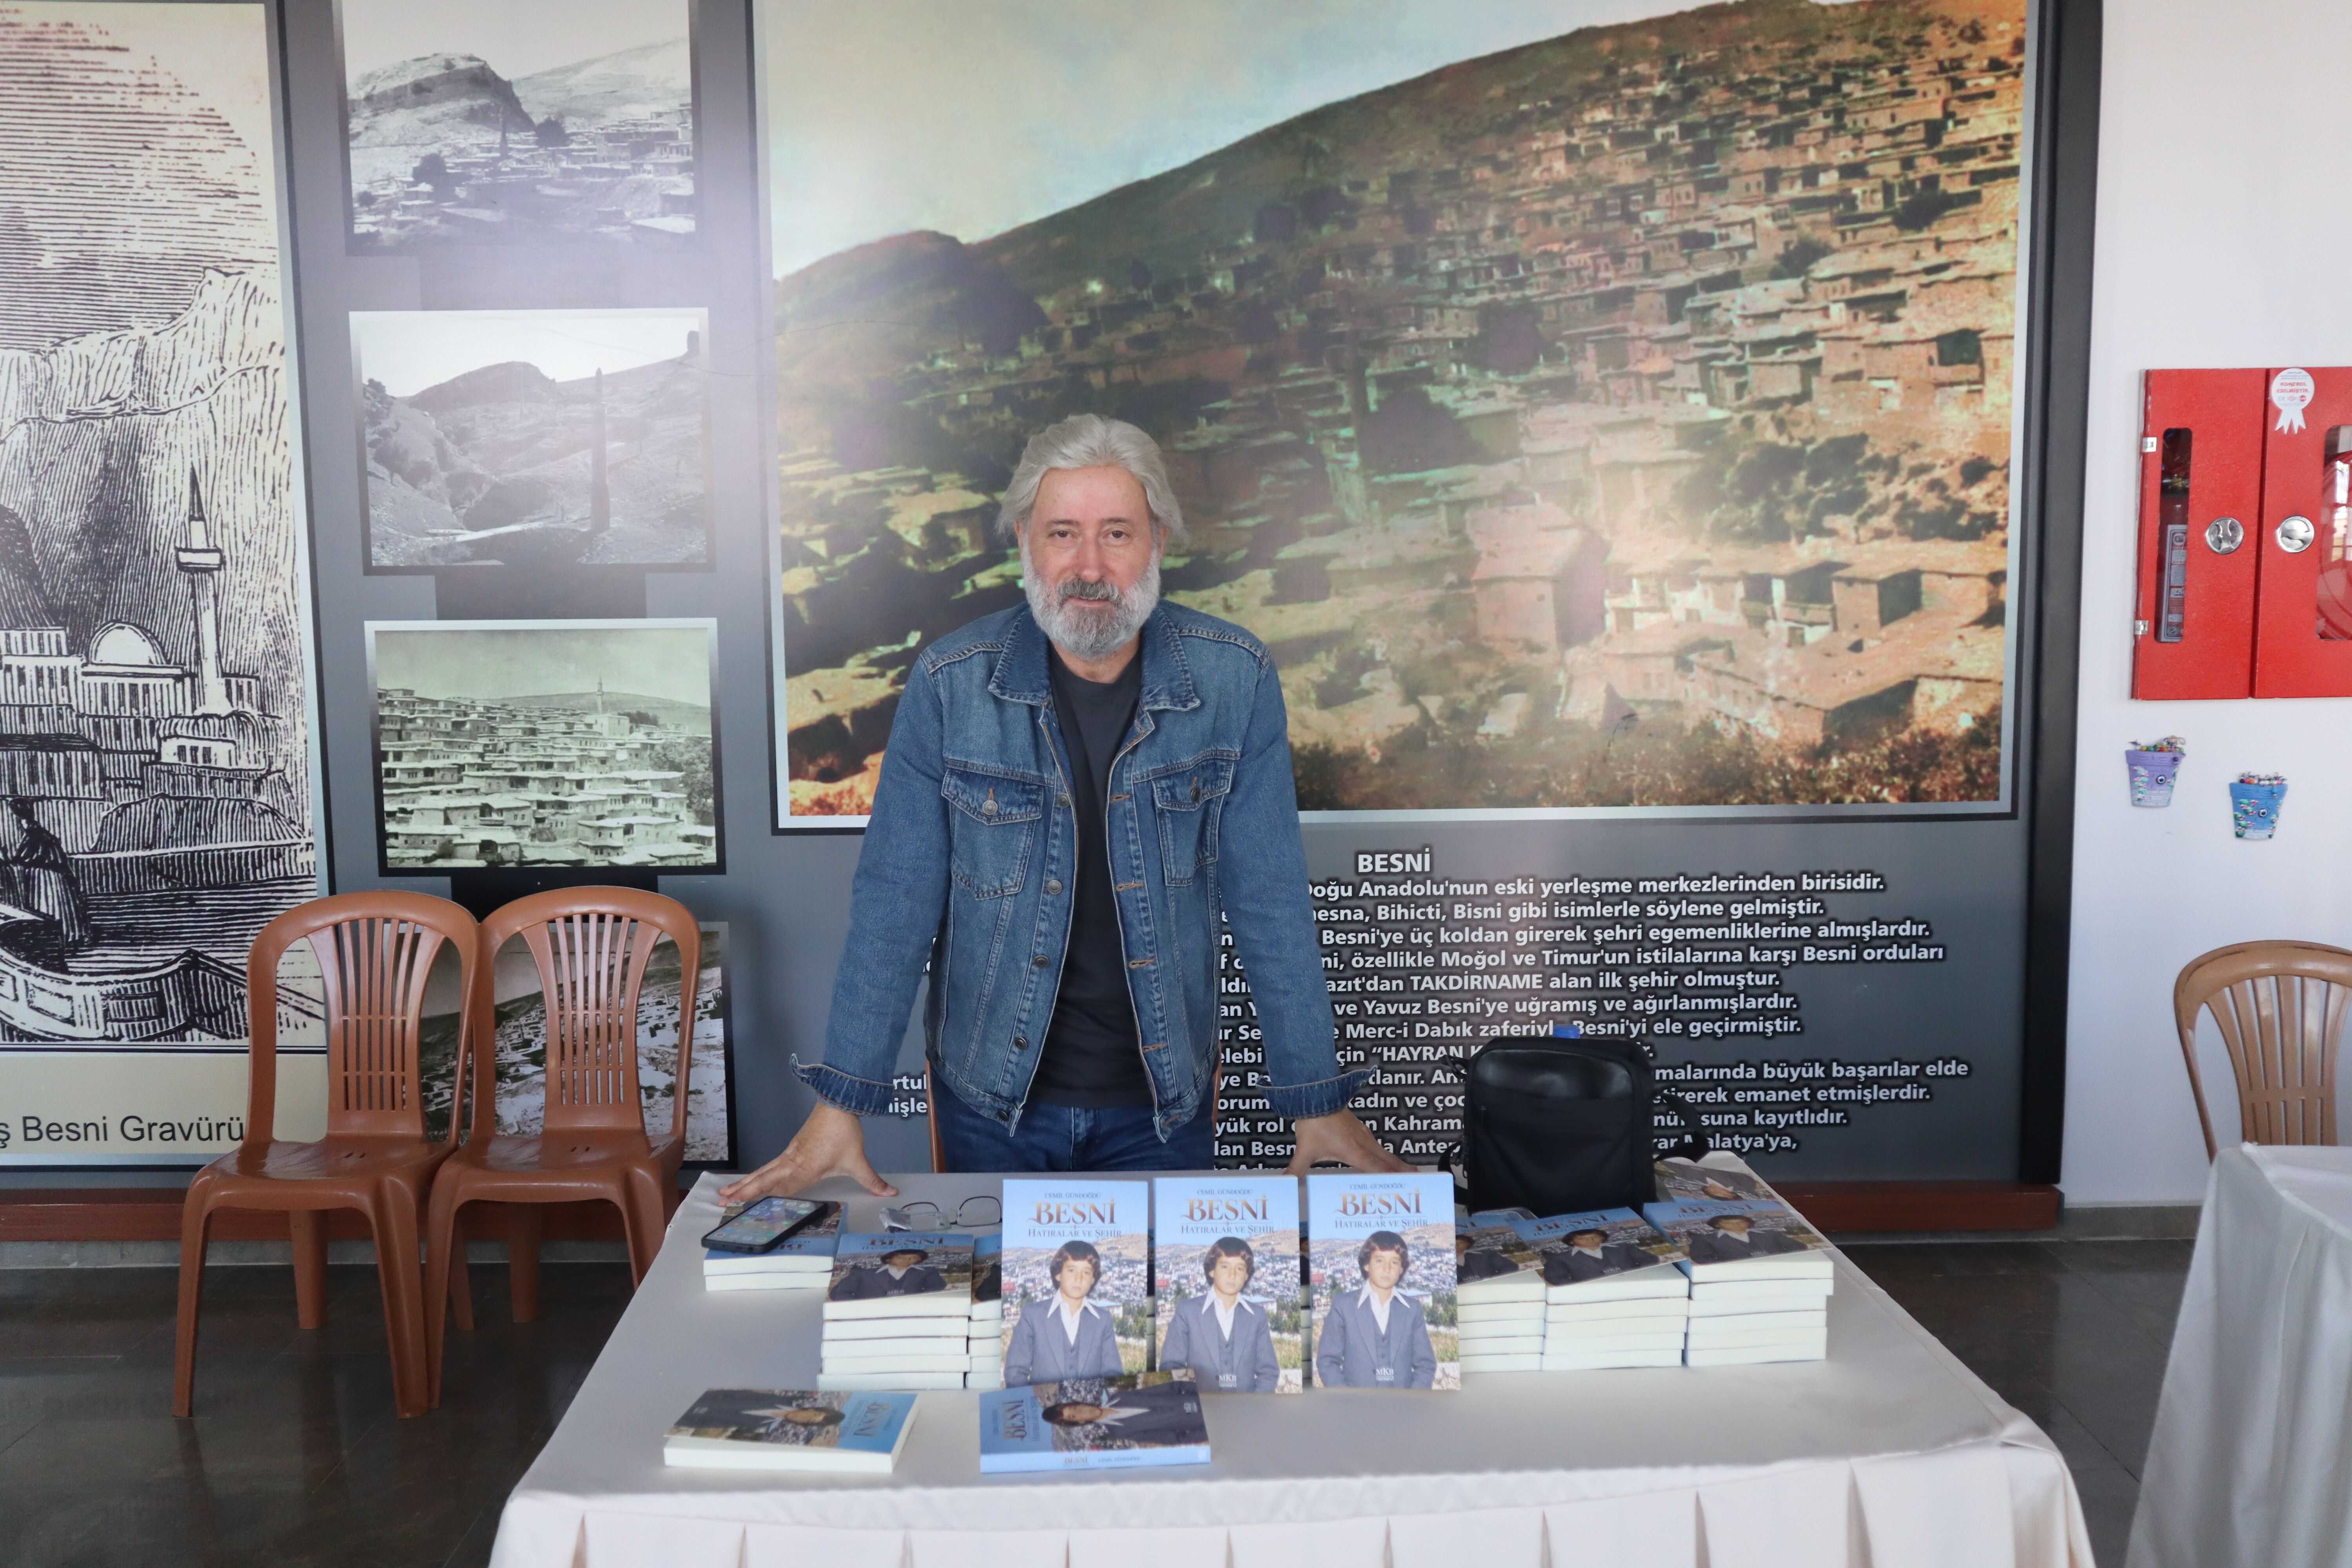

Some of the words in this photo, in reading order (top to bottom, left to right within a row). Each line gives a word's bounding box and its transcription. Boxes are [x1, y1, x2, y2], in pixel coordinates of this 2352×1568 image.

[1358, 848, 1430, 873] BESNİ
[1309, 881, 1352, 901] oğu
[1359, 880, 1488, 897] Anadolu'nun
[1494, 878, 1534, 895] eski
[1540, 877, 1632, 898] yerleşme
[1639, 875, 1795, 892] merkezlerinden
[1802, 873, 1884, 890] birisidir.
[1377, 903, 1446, 921] Bihicti,
[1454, 902, 1501, 919] Bisni
[1508, 902, 1547, 922] gibi
[1554, 900, 1640, 917] isimlerle
[1646, 900, 1724, 920] söylene
[1730, 898, 1824, 919] gelmiştir.
[1323, 928, 1403, 948] Besni'ye
[1410, 927, 1433, 947] üç
[1440, 926, 1508, 943] koldan
[1515, 925, 1587, 946] girerek
[1594, 924, 1642, 945] şehri
[1649, 922, 1811, 944] egemenliklerine
[1818, 920, 1929, 941] almışlardır.
[1352, 951, 1435, 968] özellikle
[1442, 950, 1506, 970] Moğol
[1512, 954, 1536, 965] ve
[1542, 949, 1630, 965] Timur'un
[1637, 947, 1742, 964] istilalarına
[1750, 946, 1796, 965] karşı
[1804, 945, 1856, 961] Besni
[1863, 944, 1943, 960] orduları
[1410, 971, 1543, 990] TAKDİRNAME
[1550, 973, 1592, 988] alan
[1599, 972, 1622, 987] ilk
[1629, 971, 1678, 991] şehir
[1684, 971, 1779, 990] olmuştur.
[1334, 1004, 1357, 1015] ve
[1363, 1000, 1421, 1014] Yavuz
[1428, 997, 1508, 1017] Besni'ye
[1515, 996, 1597, 1016] uğramış
[1603, 1000, 1626, 1011] ve
[1633, 993, 1797, 1014] ağırlanmışlardır.
[1347, 1022, 1408, 1038] Merc-i
[1416, 1021, 1473, 1037] Dabık
[1479, 1020, 1553, 1037] zaferiyl
[1654, 1018, 1682, 1033] ele
[1690, 1016, 1800, 1037] geçirmiştir.
[1764, 1063, 1824, 1082] büyük
[1833, 1062, 1919, 1081] başarılar
[1926, 1060, 1967, 1075] elde
[1405, 1096, 1427, 1107] ve
[1735, 1088, 1810, 1102] emanet
[1817, 1084, 1931, 1104] etmişlerdir.
[22, 1116, 108, 1142] Besni
[120, 1115, 244, 1142] Gravürü
[1258, 1117, 1283, 1132] rol
[1385, 1115, 1465, 1131] Kahram
[1755, 1109, 1847, 1128] kayıtlıdır.
[1027, 1198, 1116, 1225] BESNİ
[1180, 1194, 1269, 1222] BESNİ
[1334, 1187, 1424, 1216] BESNİ
